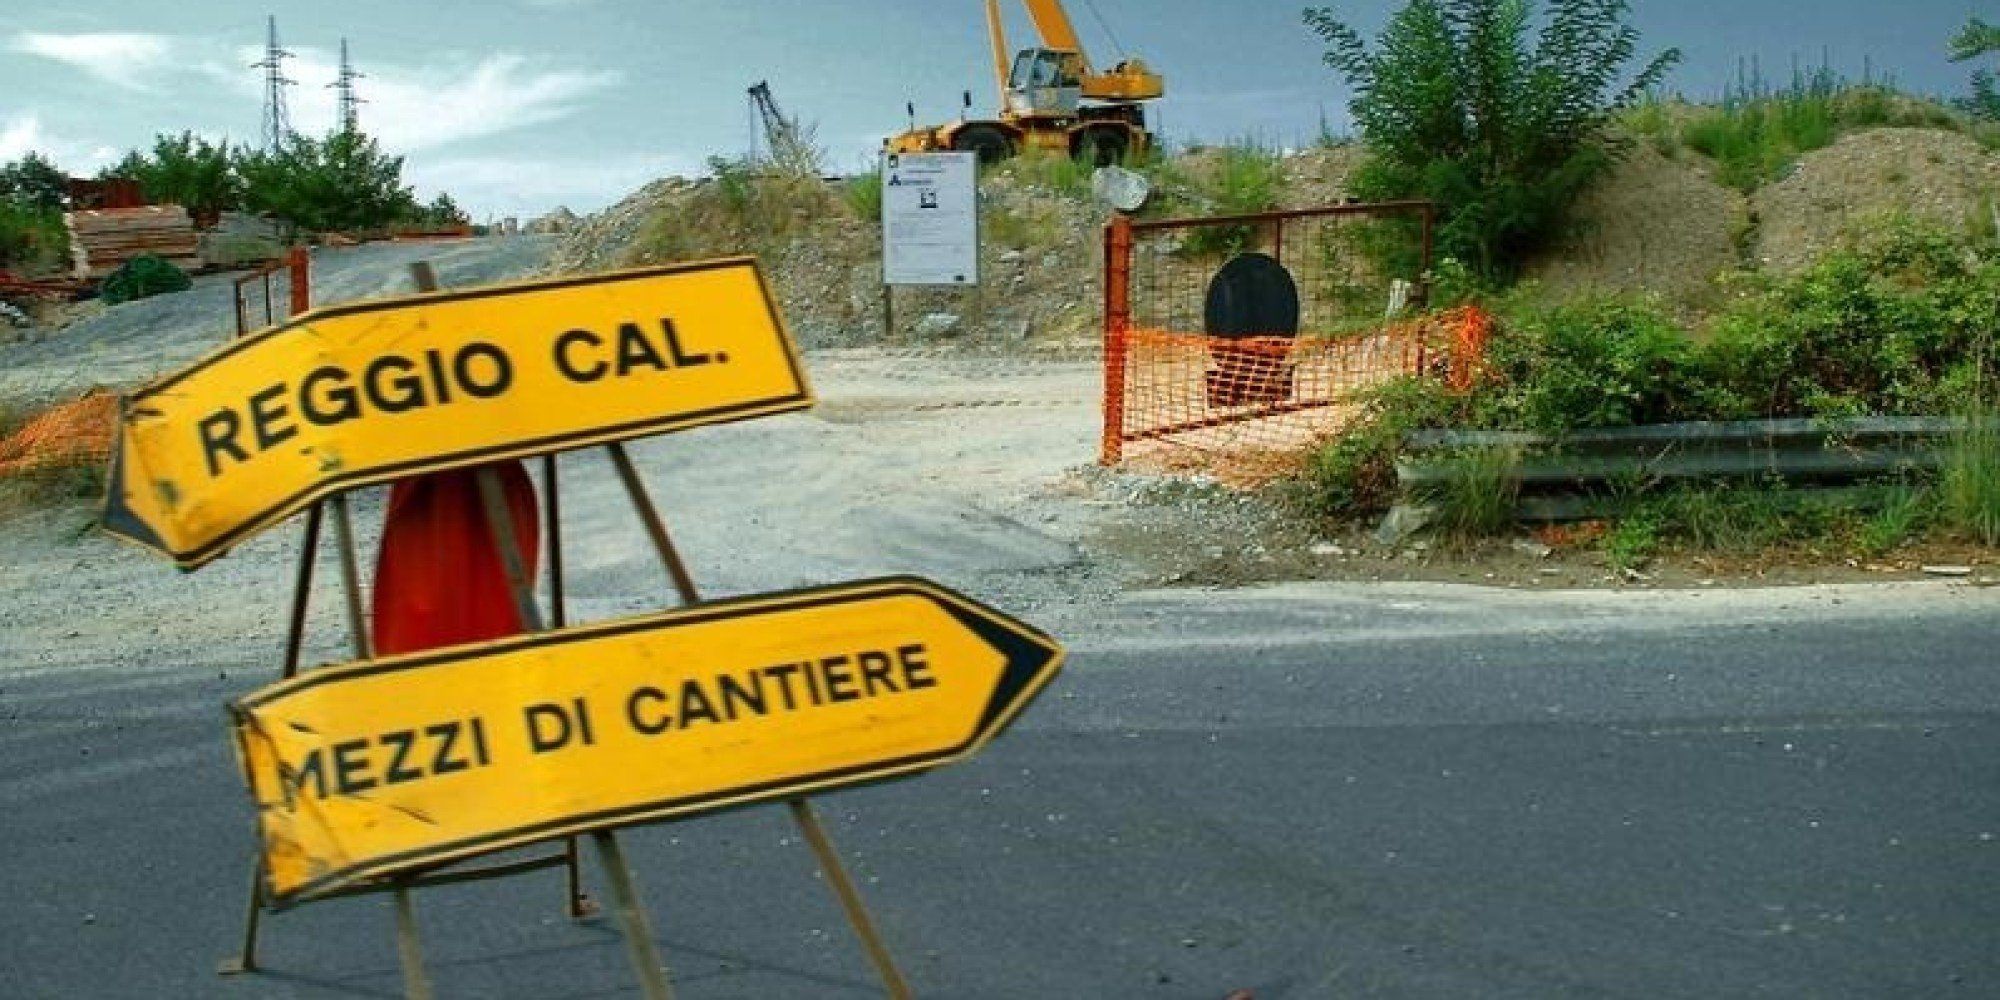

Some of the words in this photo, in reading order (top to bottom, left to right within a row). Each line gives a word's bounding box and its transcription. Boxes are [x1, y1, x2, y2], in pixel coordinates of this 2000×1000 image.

[197, 342, 514, 477] REGGIO
[554, 317, 729, 384] CAL.
[279, 717, 491, 810] MEZZI
[523, 696, 596, 754] DI
[625, 644, 938, 735] CANTIERE
